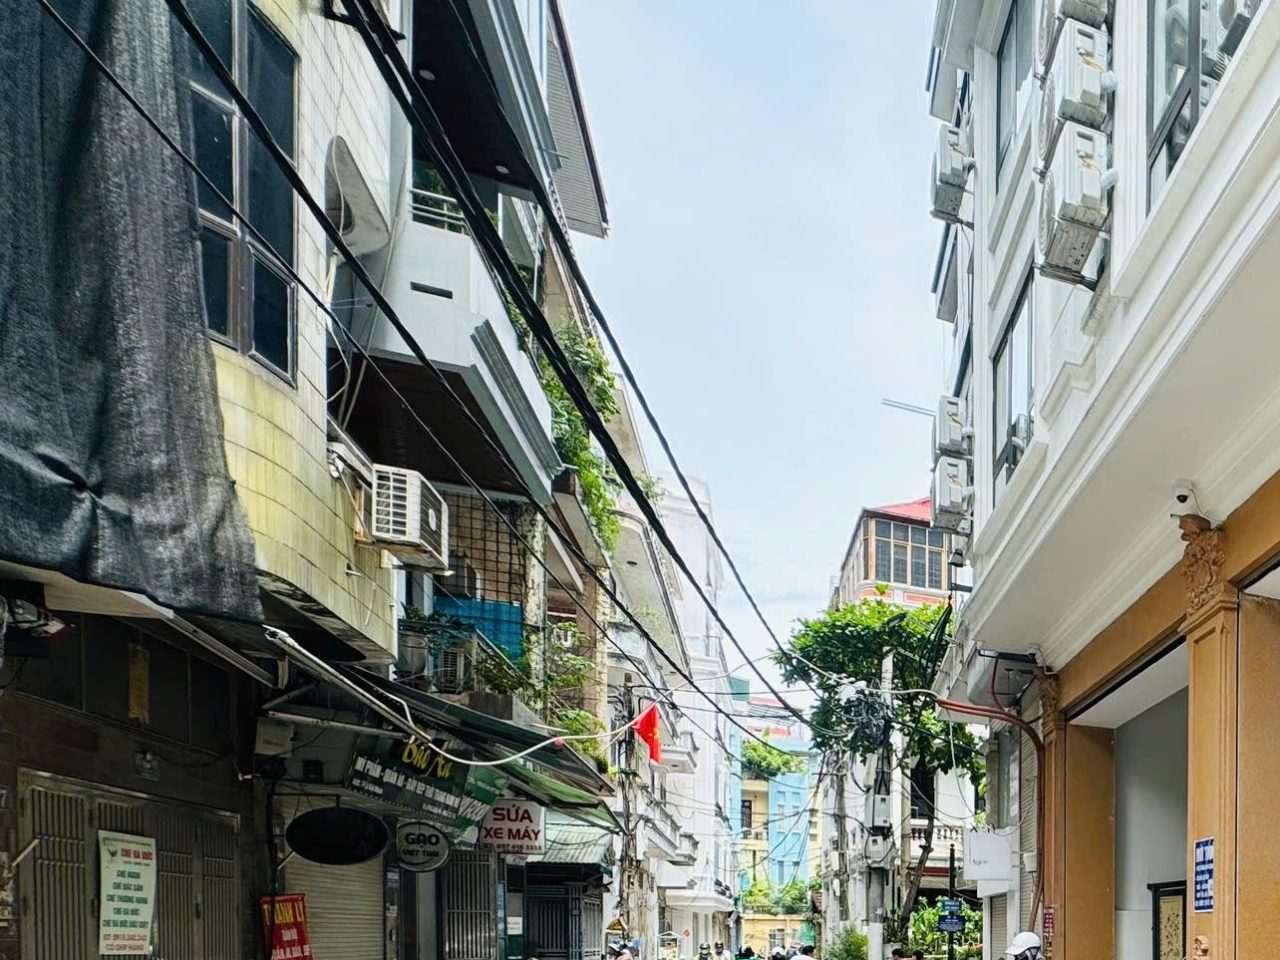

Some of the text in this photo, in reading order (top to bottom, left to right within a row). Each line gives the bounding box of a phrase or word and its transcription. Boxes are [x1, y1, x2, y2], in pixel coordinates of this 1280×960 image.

[492, 804, 533, 824] SỬA
[405, 832, 440, 848] GẠO
[483, 826, 541, 841] XE MÁY
